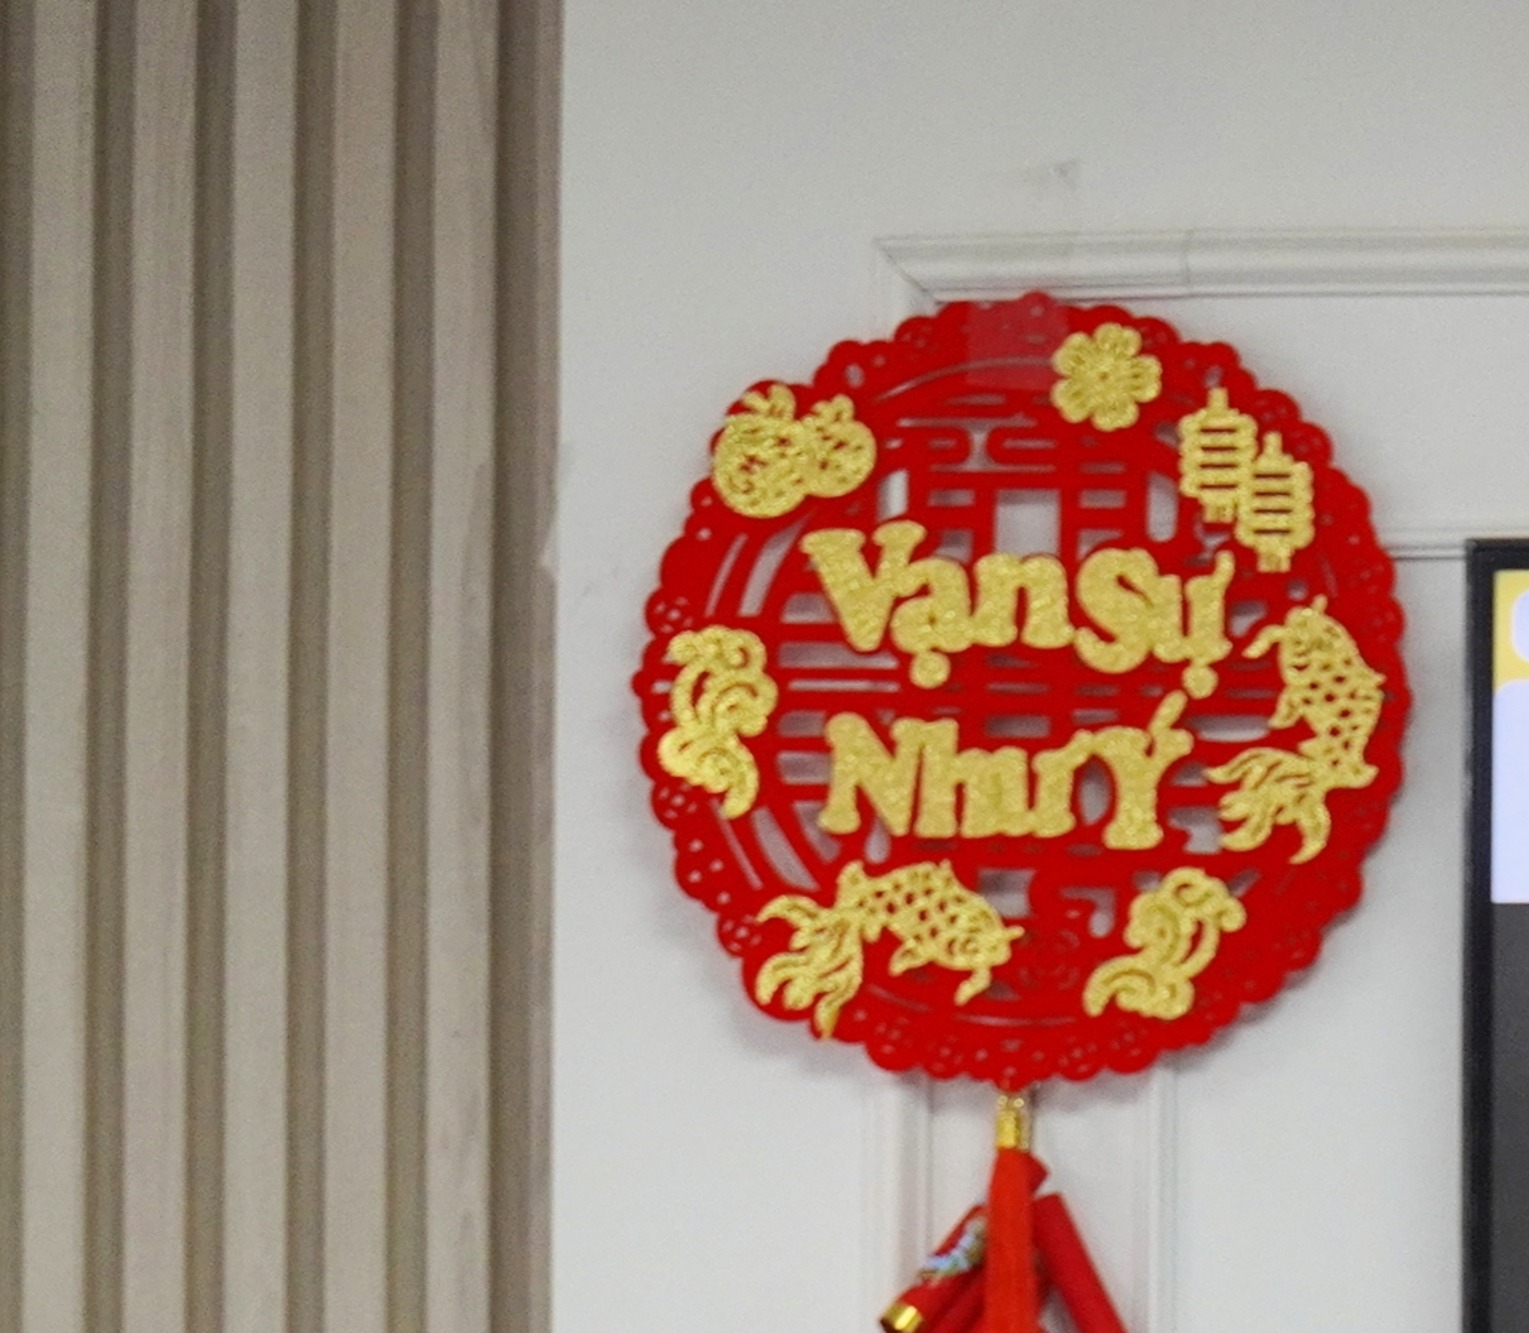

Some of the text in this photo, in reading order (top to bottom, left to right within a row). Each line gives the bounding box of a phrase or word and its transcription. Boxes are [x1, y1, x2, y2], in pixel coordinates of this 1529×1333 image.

[801, 520, 1234, 698] Vạn Sự
[817, 713, 1100, 838] Như
